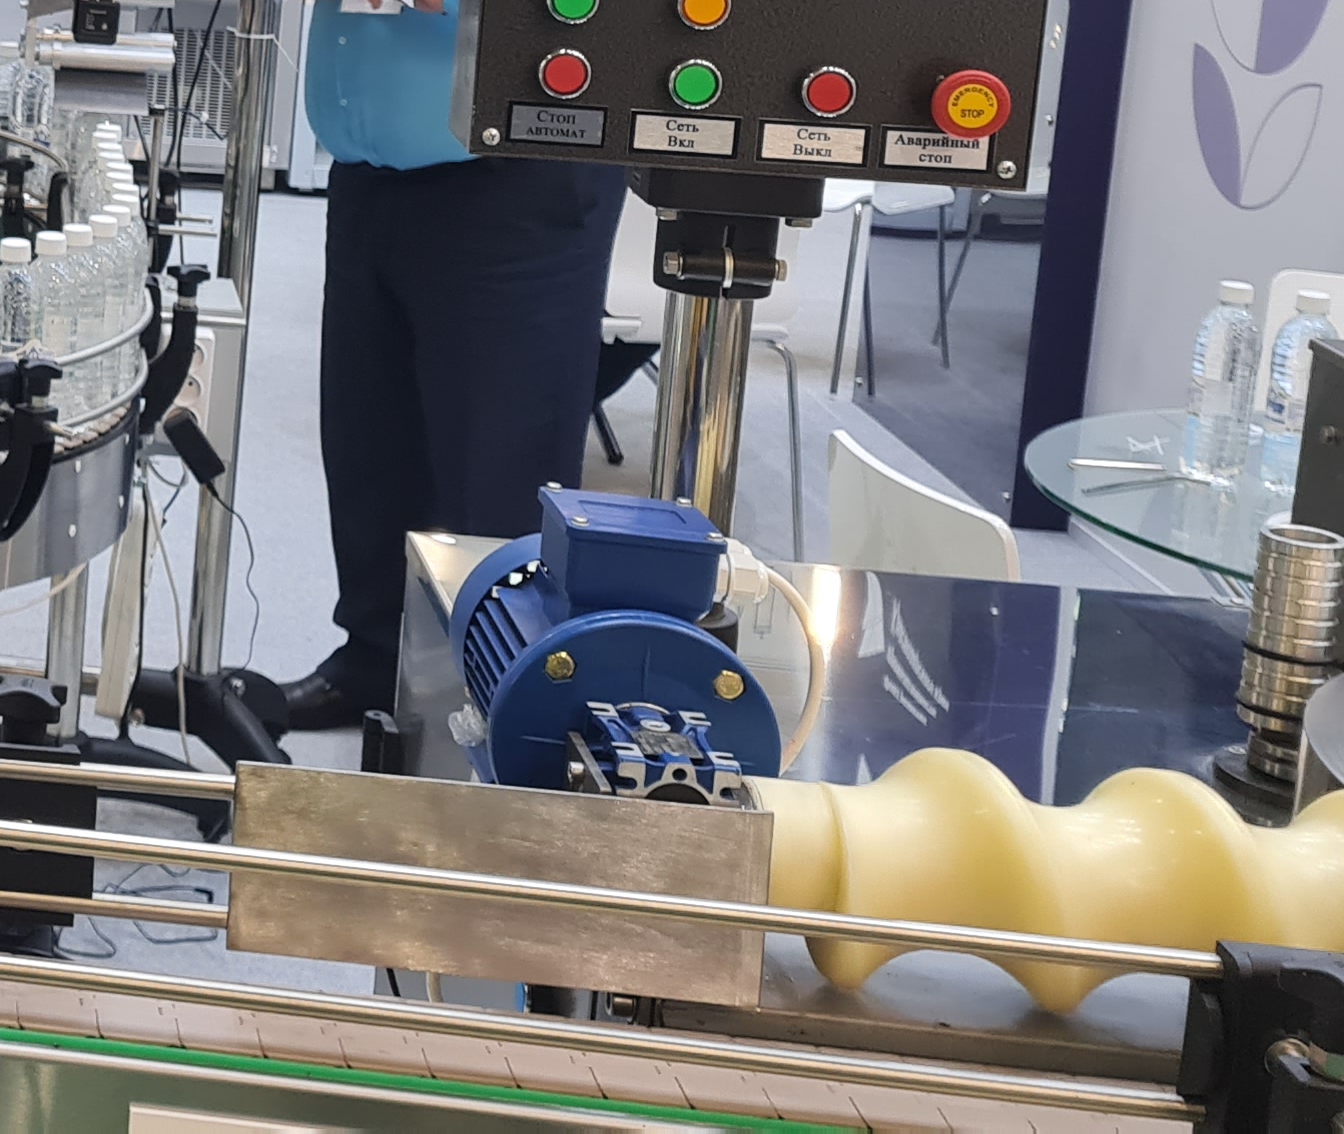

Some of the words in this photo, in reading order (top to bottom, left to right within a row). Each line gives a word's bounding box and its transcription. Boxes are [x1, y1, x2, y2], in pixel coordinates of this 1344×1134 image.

[951, 86, 995, 108] EMERGENCY
[960, 109, 985, 118] STOP
[526, 126, 586, 139] АВТОМАТ
[665, 119, 699, 133] Сеть
[667, 135, 695, 148] Вкл
[796, 128, 831, 142] Сеть
[894, 133, 980, 150] Аварийный
[792, 143, 832, 158] Выкл
[918, 153, 953, 164] стоп
